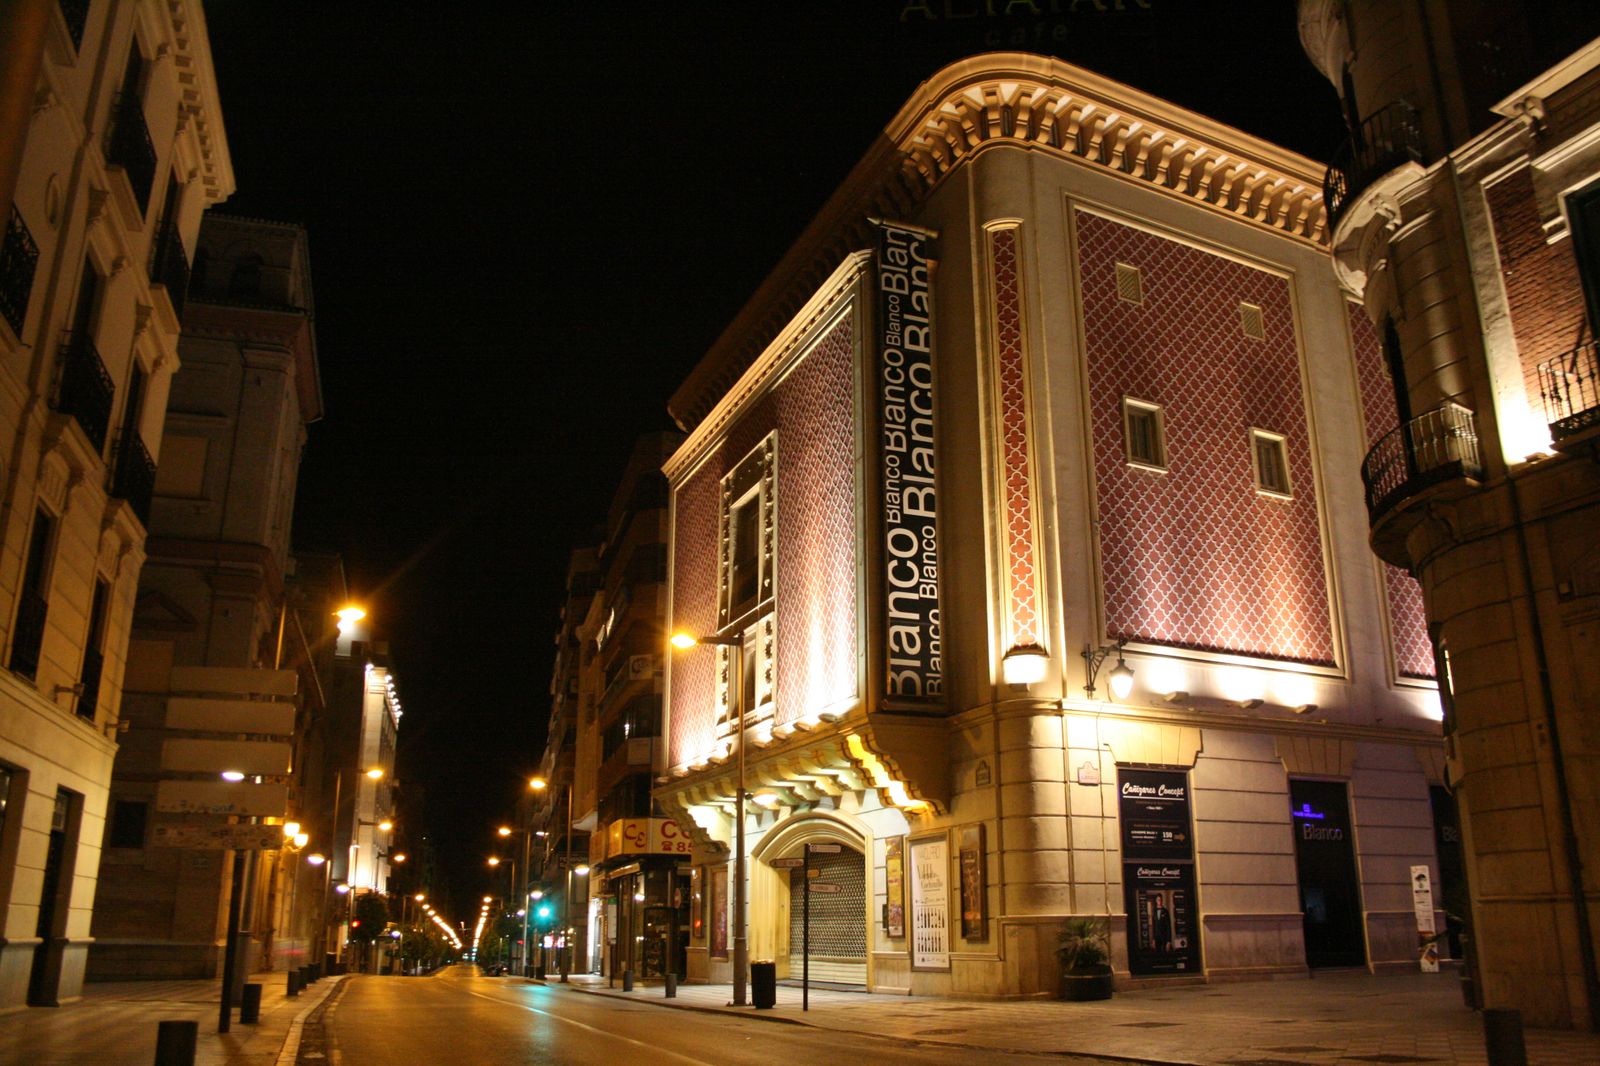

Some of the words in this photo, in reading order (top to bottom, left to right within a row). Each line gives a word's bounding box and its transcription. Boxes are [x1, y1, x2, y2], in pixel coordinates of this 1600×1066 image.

[886, 294, 900, 347] Blanco
[883, 348, 908, 454] Blanco
[902, 361, 937, 519] Blanco
[885, 454, 901, 524] Blanco
[919, 525, 938, 600] Blanco
[887, 527, 922, 697] Blanco
[925, 608, 944, 696] Blanco
[1158, 784, 1185, 796] Concept
[1303, 824, 1343, 841] Blanco
